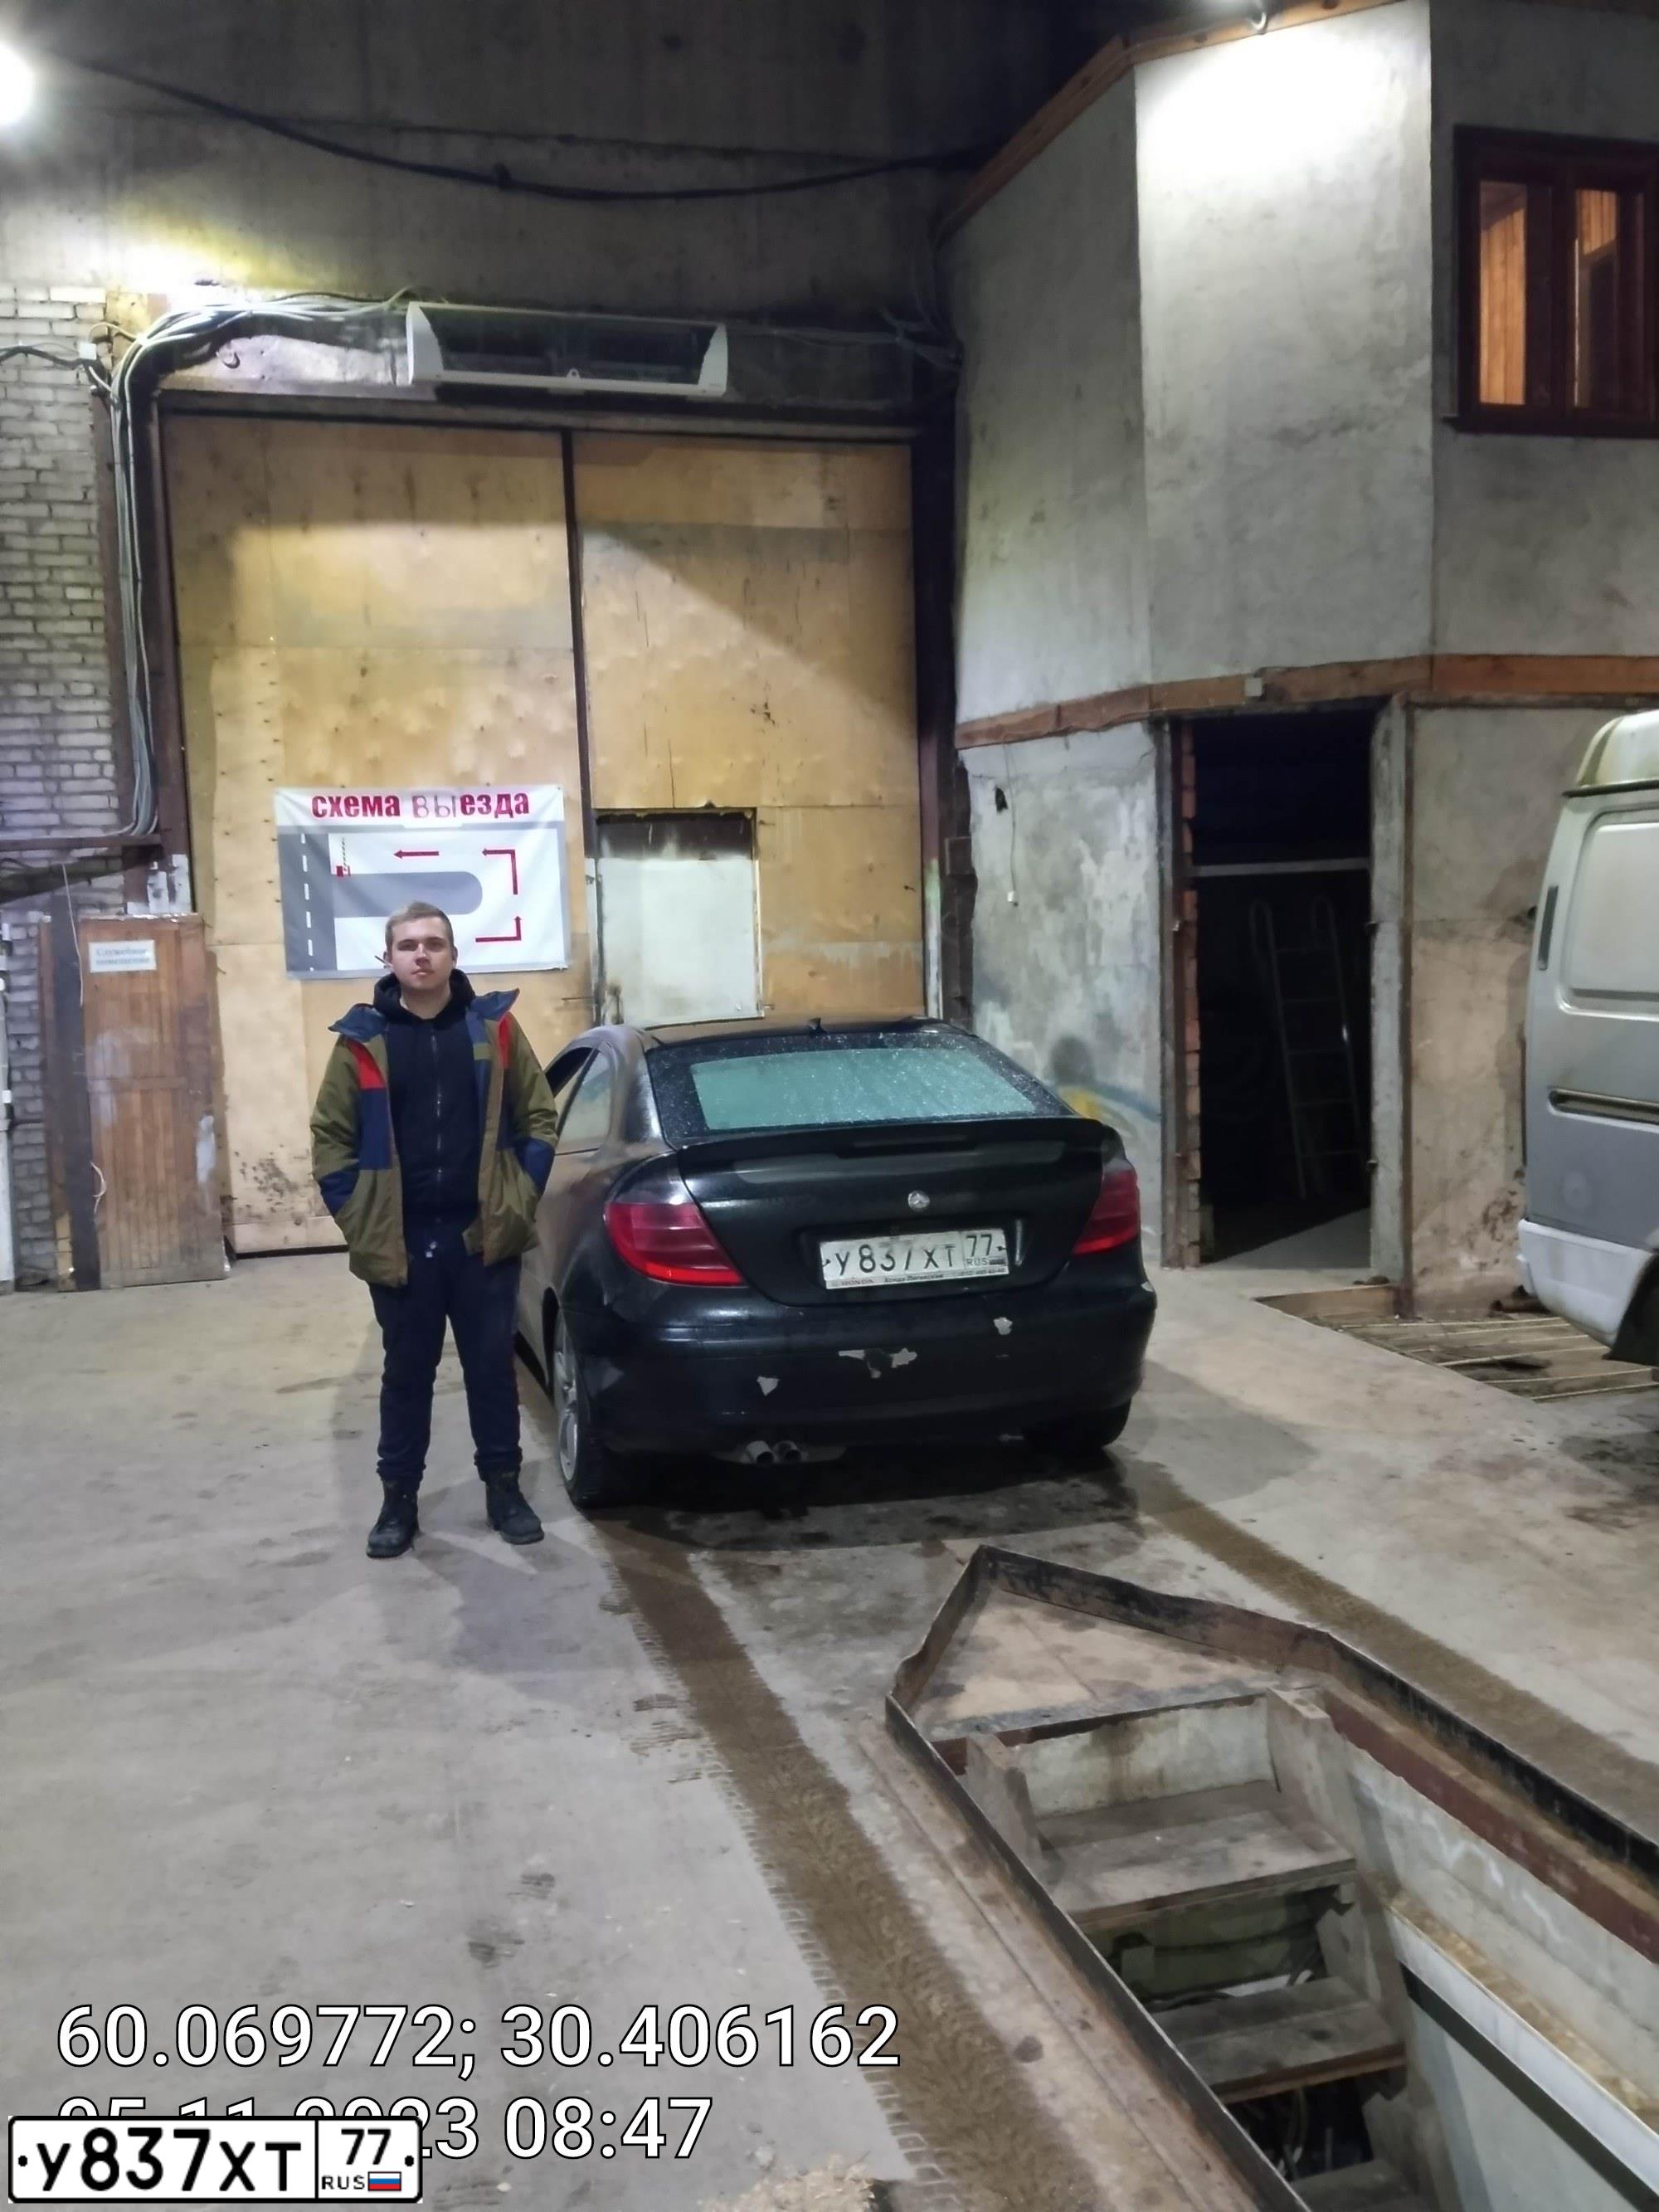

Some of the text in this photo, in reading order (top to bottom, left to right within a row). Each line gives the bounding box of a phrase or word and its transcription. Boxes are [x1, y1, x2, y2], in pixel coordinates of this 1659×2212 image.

[312, 794, 401, 818] схема
[966, 1234, 992, 1257] 77
[966, 1257, 988, 1266] RUS
